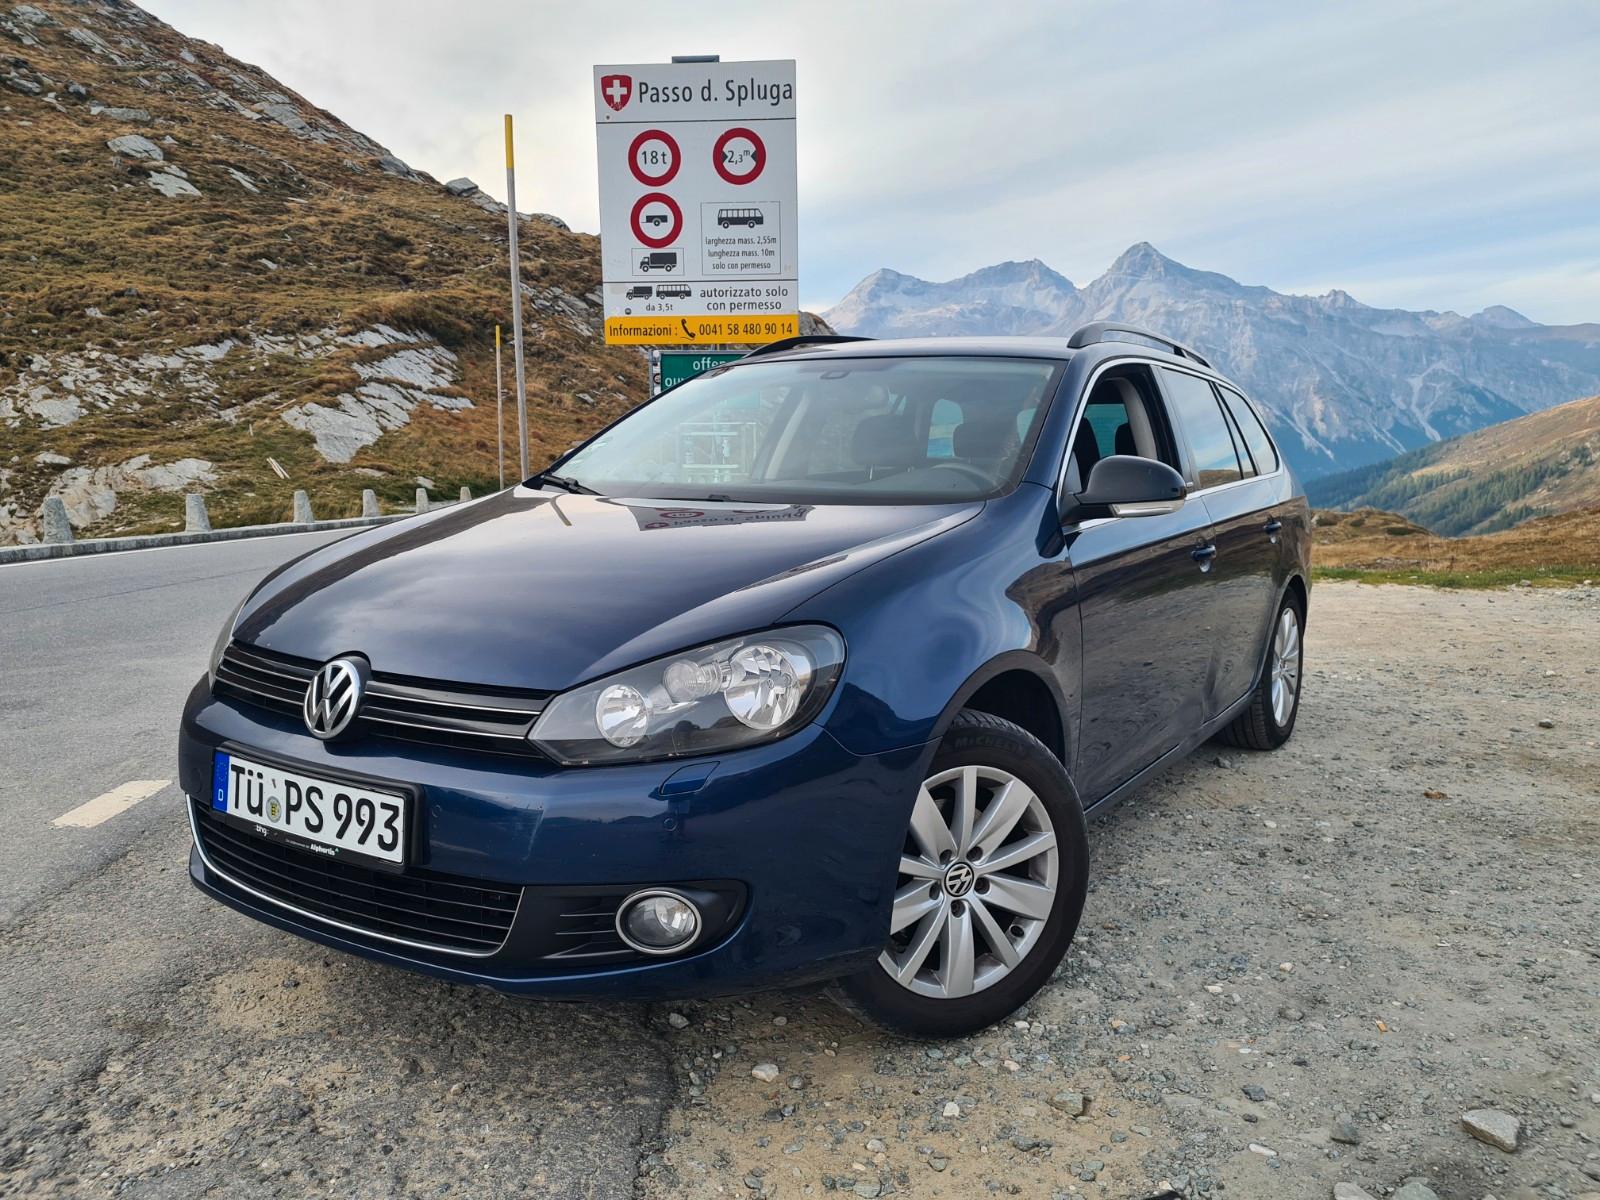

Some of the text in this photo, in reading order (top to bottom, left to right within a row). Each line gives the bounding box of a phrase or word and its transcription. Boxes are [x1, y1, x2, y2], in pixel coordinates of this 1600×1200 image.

[639, 78, 793, 106] Passo d. Spluga
[705, 236, 777, 247] larghezza mass. 2,55m
[708, 248, 775, 259] lunghezza mass. 10m
[712, 261, 771, 272] solo con permesso
[700, 286, 788, 298] autorizzato solo
[645, 303, 673, 313] da 3,5t
[706, 299, 782, 313] con permesso
[609, 324, 672, 336] Informazioni
[699, 322, 792, 336] 0041 58 480 90 14
[230, 764, 399, 852] TÜ PS 993
